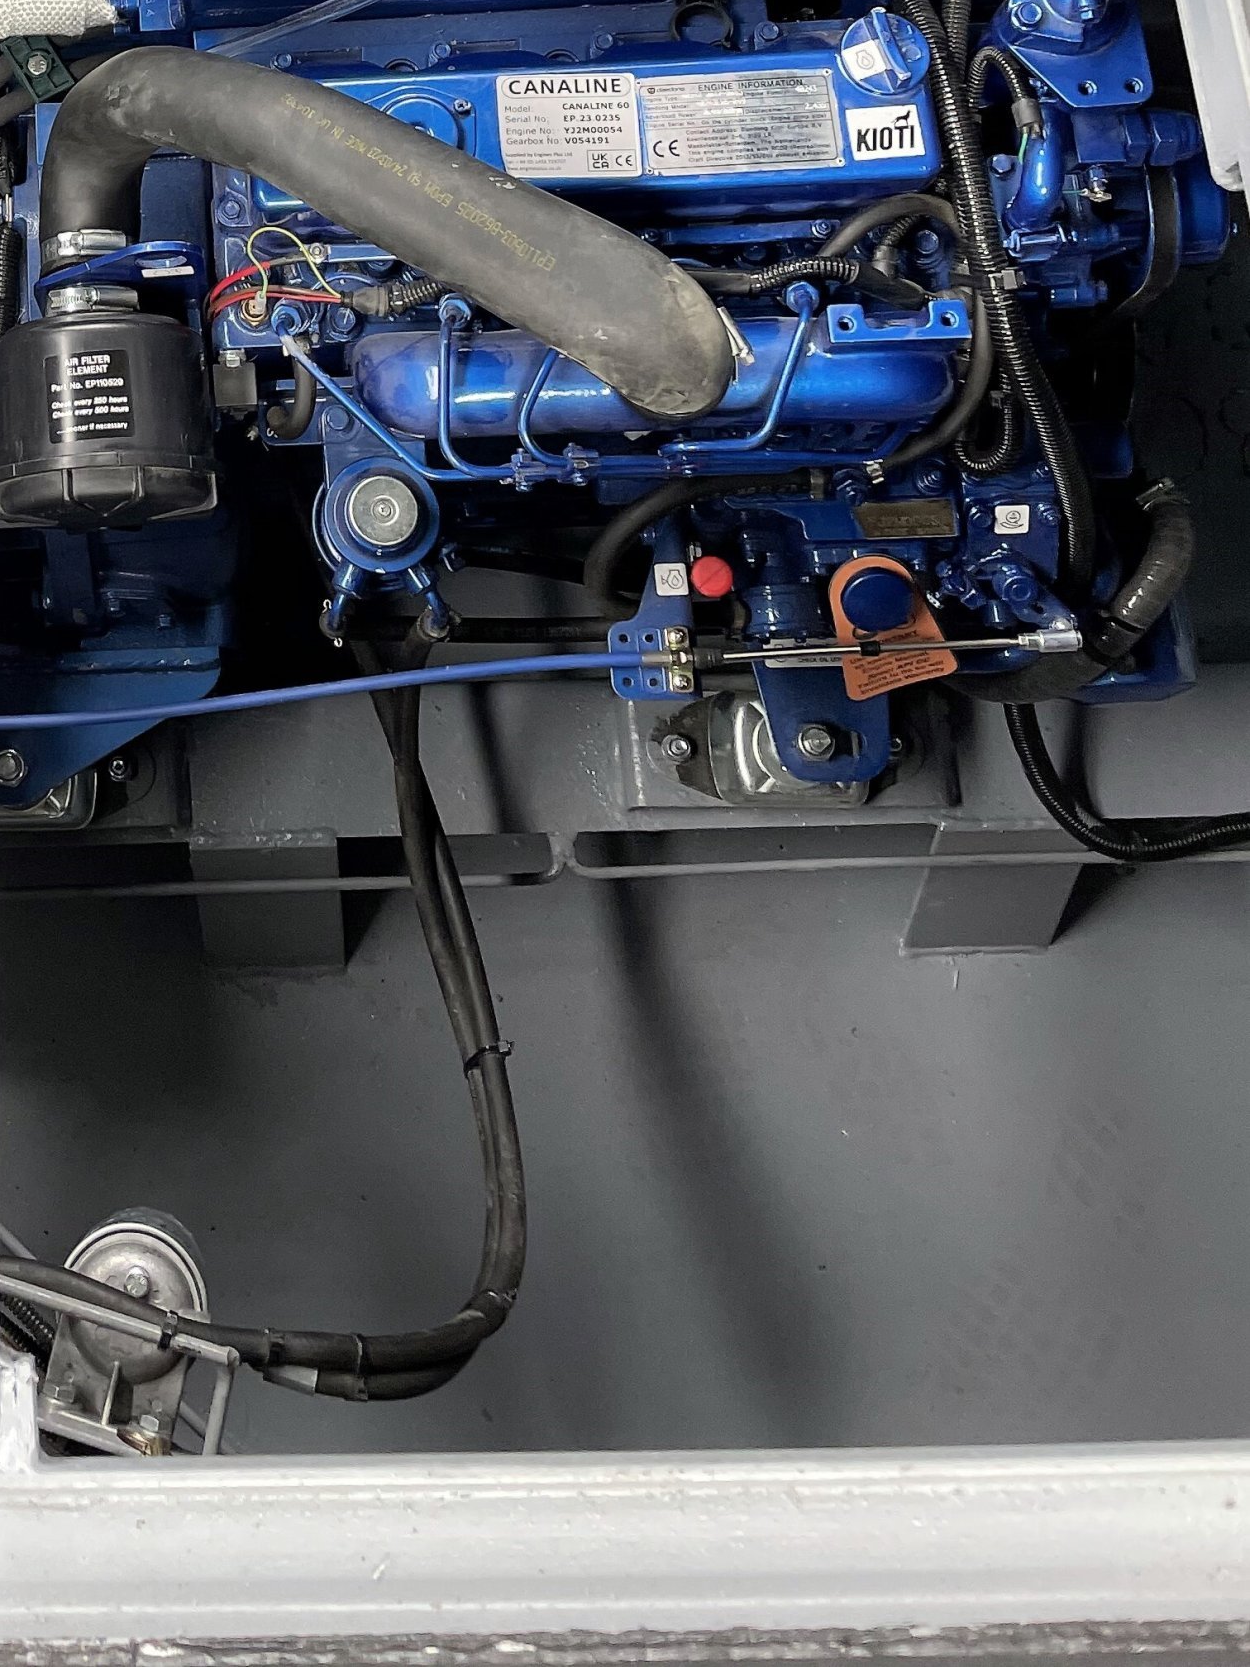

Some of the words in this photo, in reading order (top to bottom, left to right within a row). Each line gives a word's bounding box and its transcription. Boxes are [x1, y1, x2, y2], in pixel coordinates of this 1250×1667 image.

[508, 78, 622, 95] CANALINE
[698, 82, 734, 92] ENGINE
[738, 78, 804, 90] INFORMATION
[504, 105, 532, 113] Model:
[562, 102, 614, 110] CANALINE
[617, 101, 630, 109] 60
[505, 115, 532, 123] Serial
[506, 127, 537, 136] Engine
[564, 126, 623, 134] YJ2M00054
[506, 137, 543, 145] Gearbox
[564, 136, 610, 145] V054191
[856, 125, 915, 152] KIOTI
[653, 139, 680, 158] CE
[592, 153, 608, 161] UK
[615, 154, 633, 167] CE
[592, 161, 609, 169] CA
[65, 356, 79, 366] AIR
[80, 354, 111, 365] FILTER
[66, 364, 108, 376] ELEMENT
[51, 383, 68, 392] Part
[69, 381, 83, 390] No.
[73, 398, 93, 407] every
[109, 395, 128, 404] hours
[74, 408, 93, 416] every
[110, 405, 130, 413] hours
